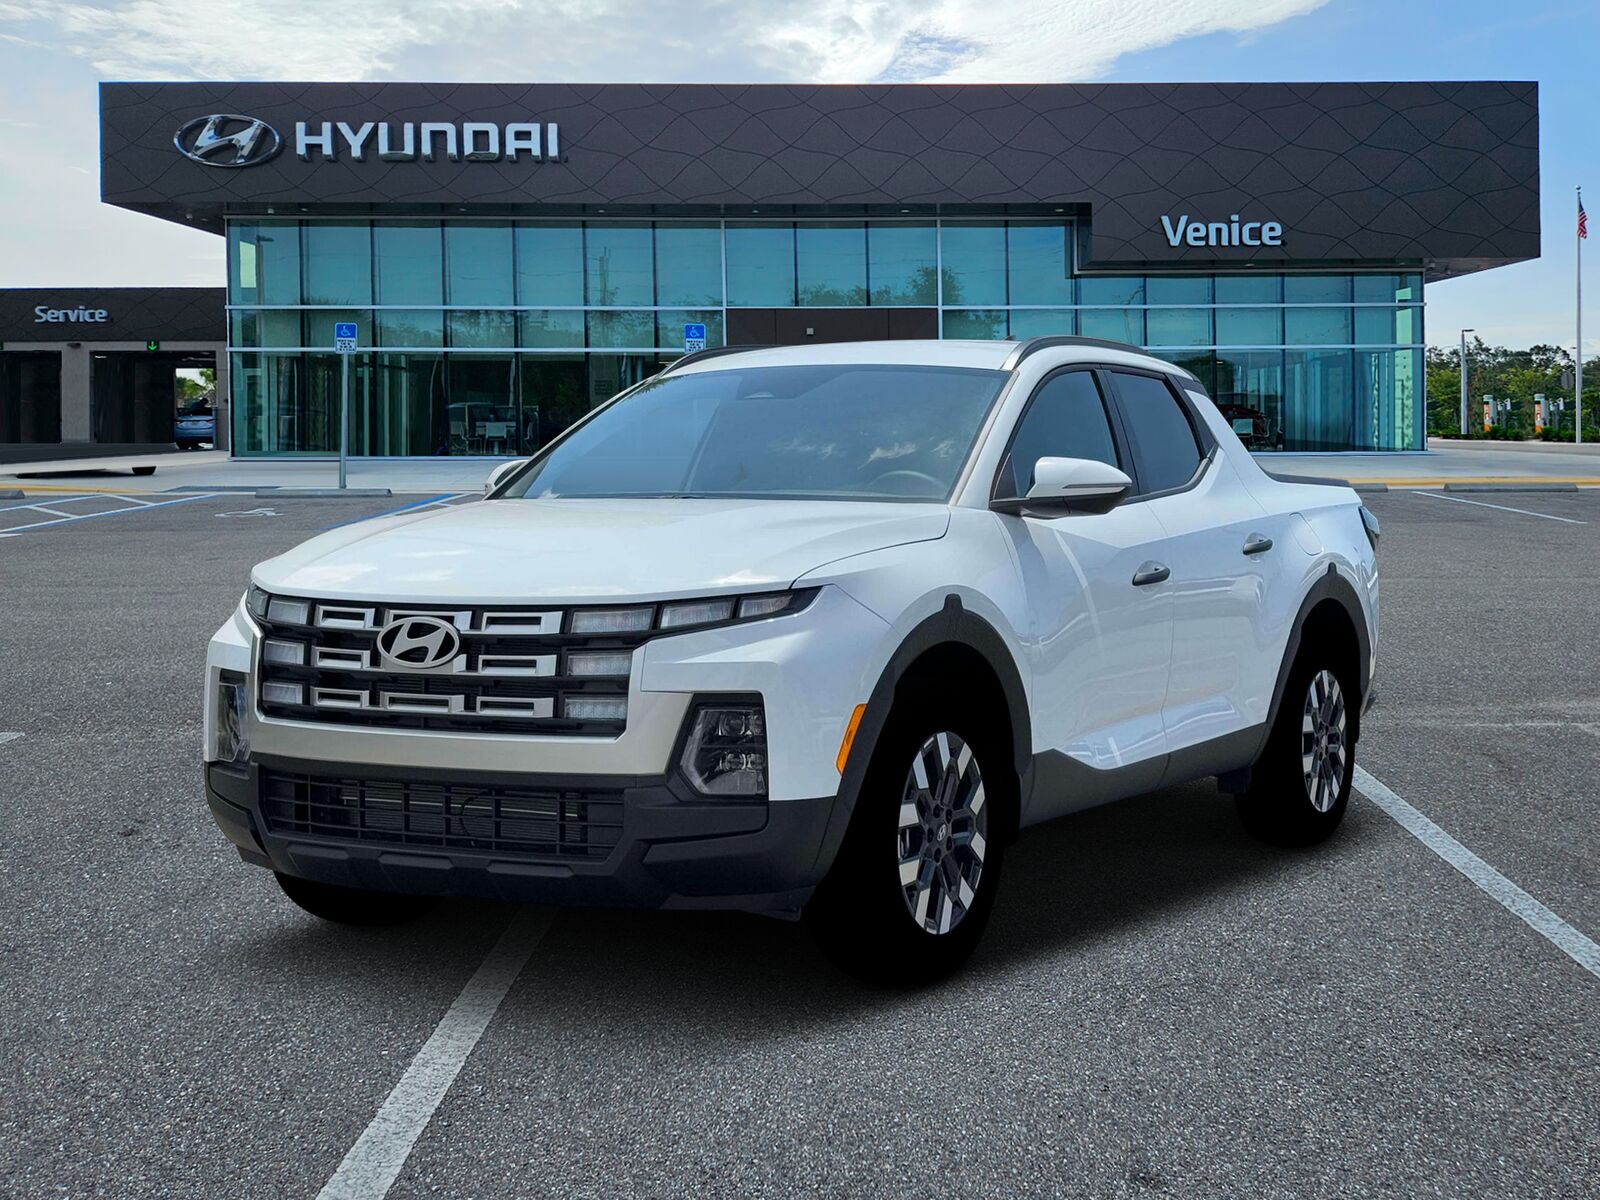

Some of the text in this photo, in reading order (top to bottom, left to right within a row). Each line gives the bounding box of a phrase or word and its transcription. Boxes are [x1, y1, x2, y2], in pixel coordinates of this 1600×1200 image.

[295, 122, 560, 162] HYUNDAI
[1160, 214, 1283, 247] Venice
[34, 305, 108, 323] Service
